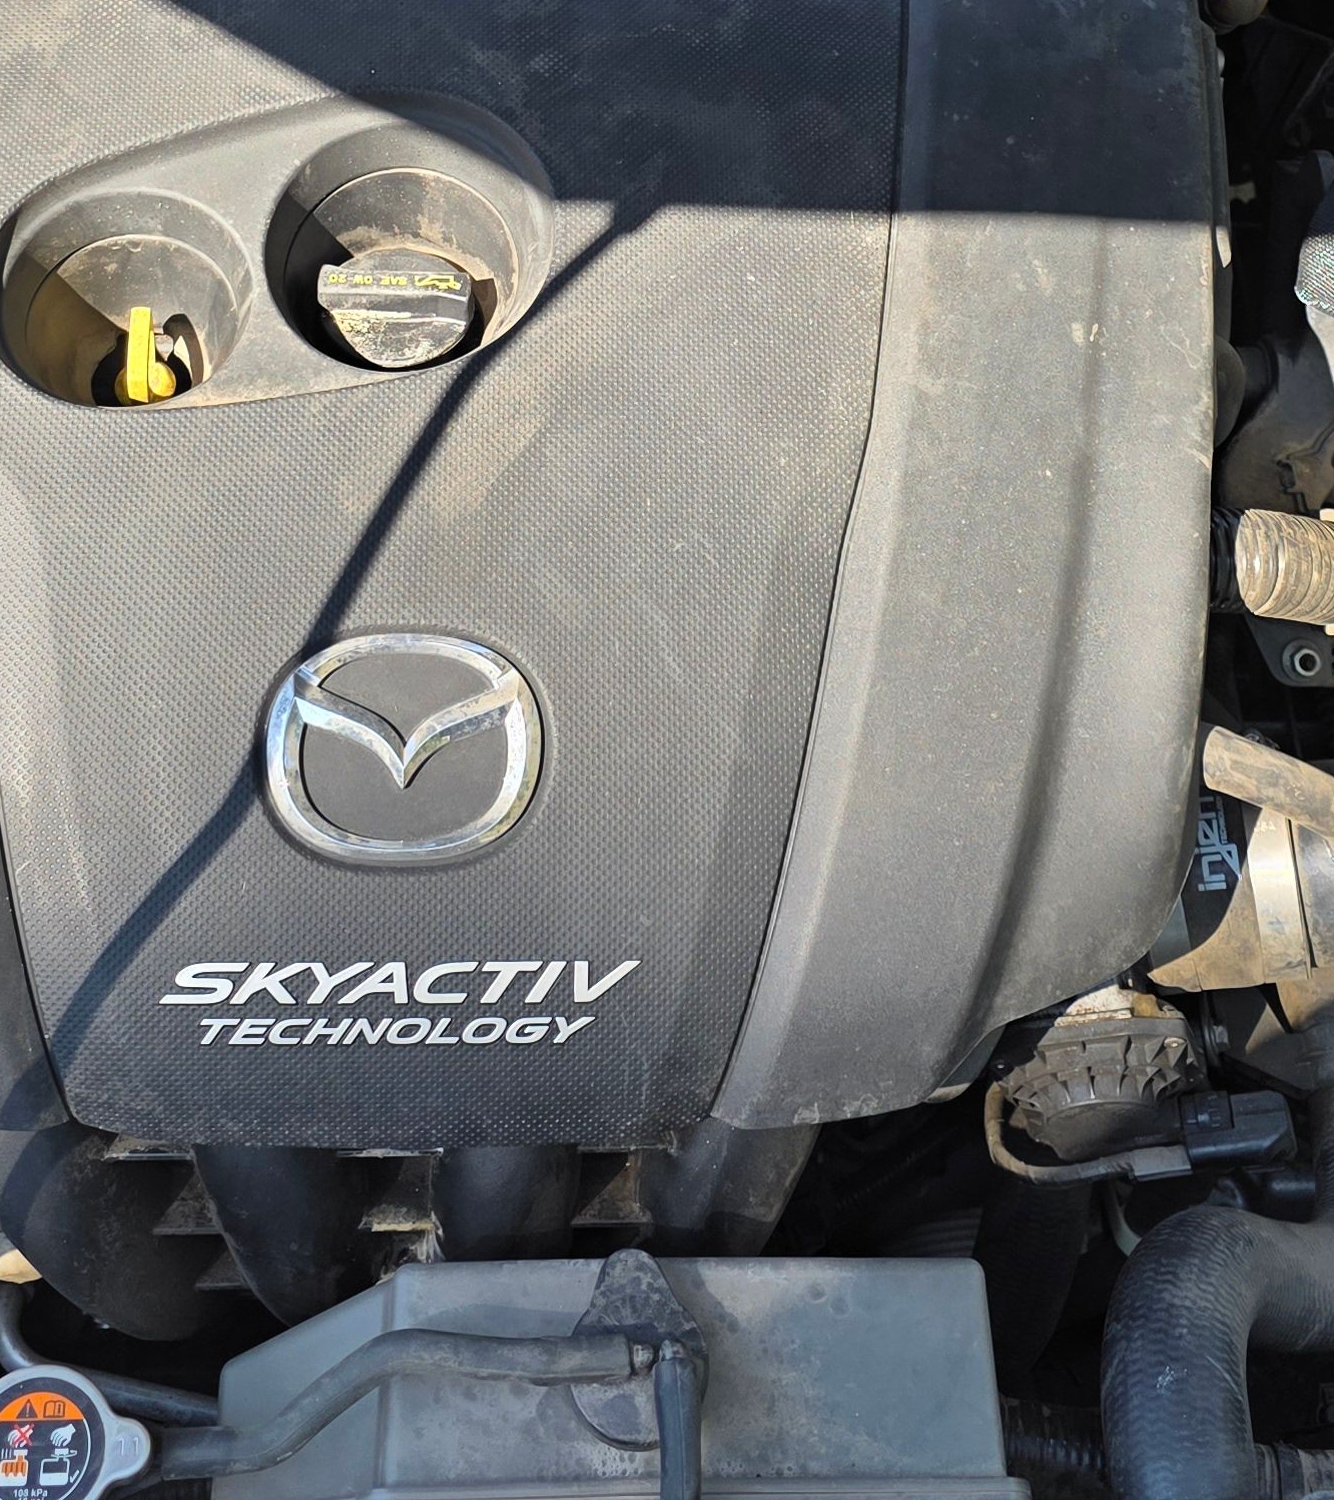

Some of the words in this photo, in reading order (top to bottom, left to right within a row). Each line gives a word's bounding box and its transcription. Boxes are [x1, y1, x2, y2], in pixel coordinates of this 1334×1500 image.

[327, 273, 374, 287] 0W-20
[158, 959, 643, 1006] SKYACTIV
[198, 1015, 596, 1046] TECHNOLOGY
